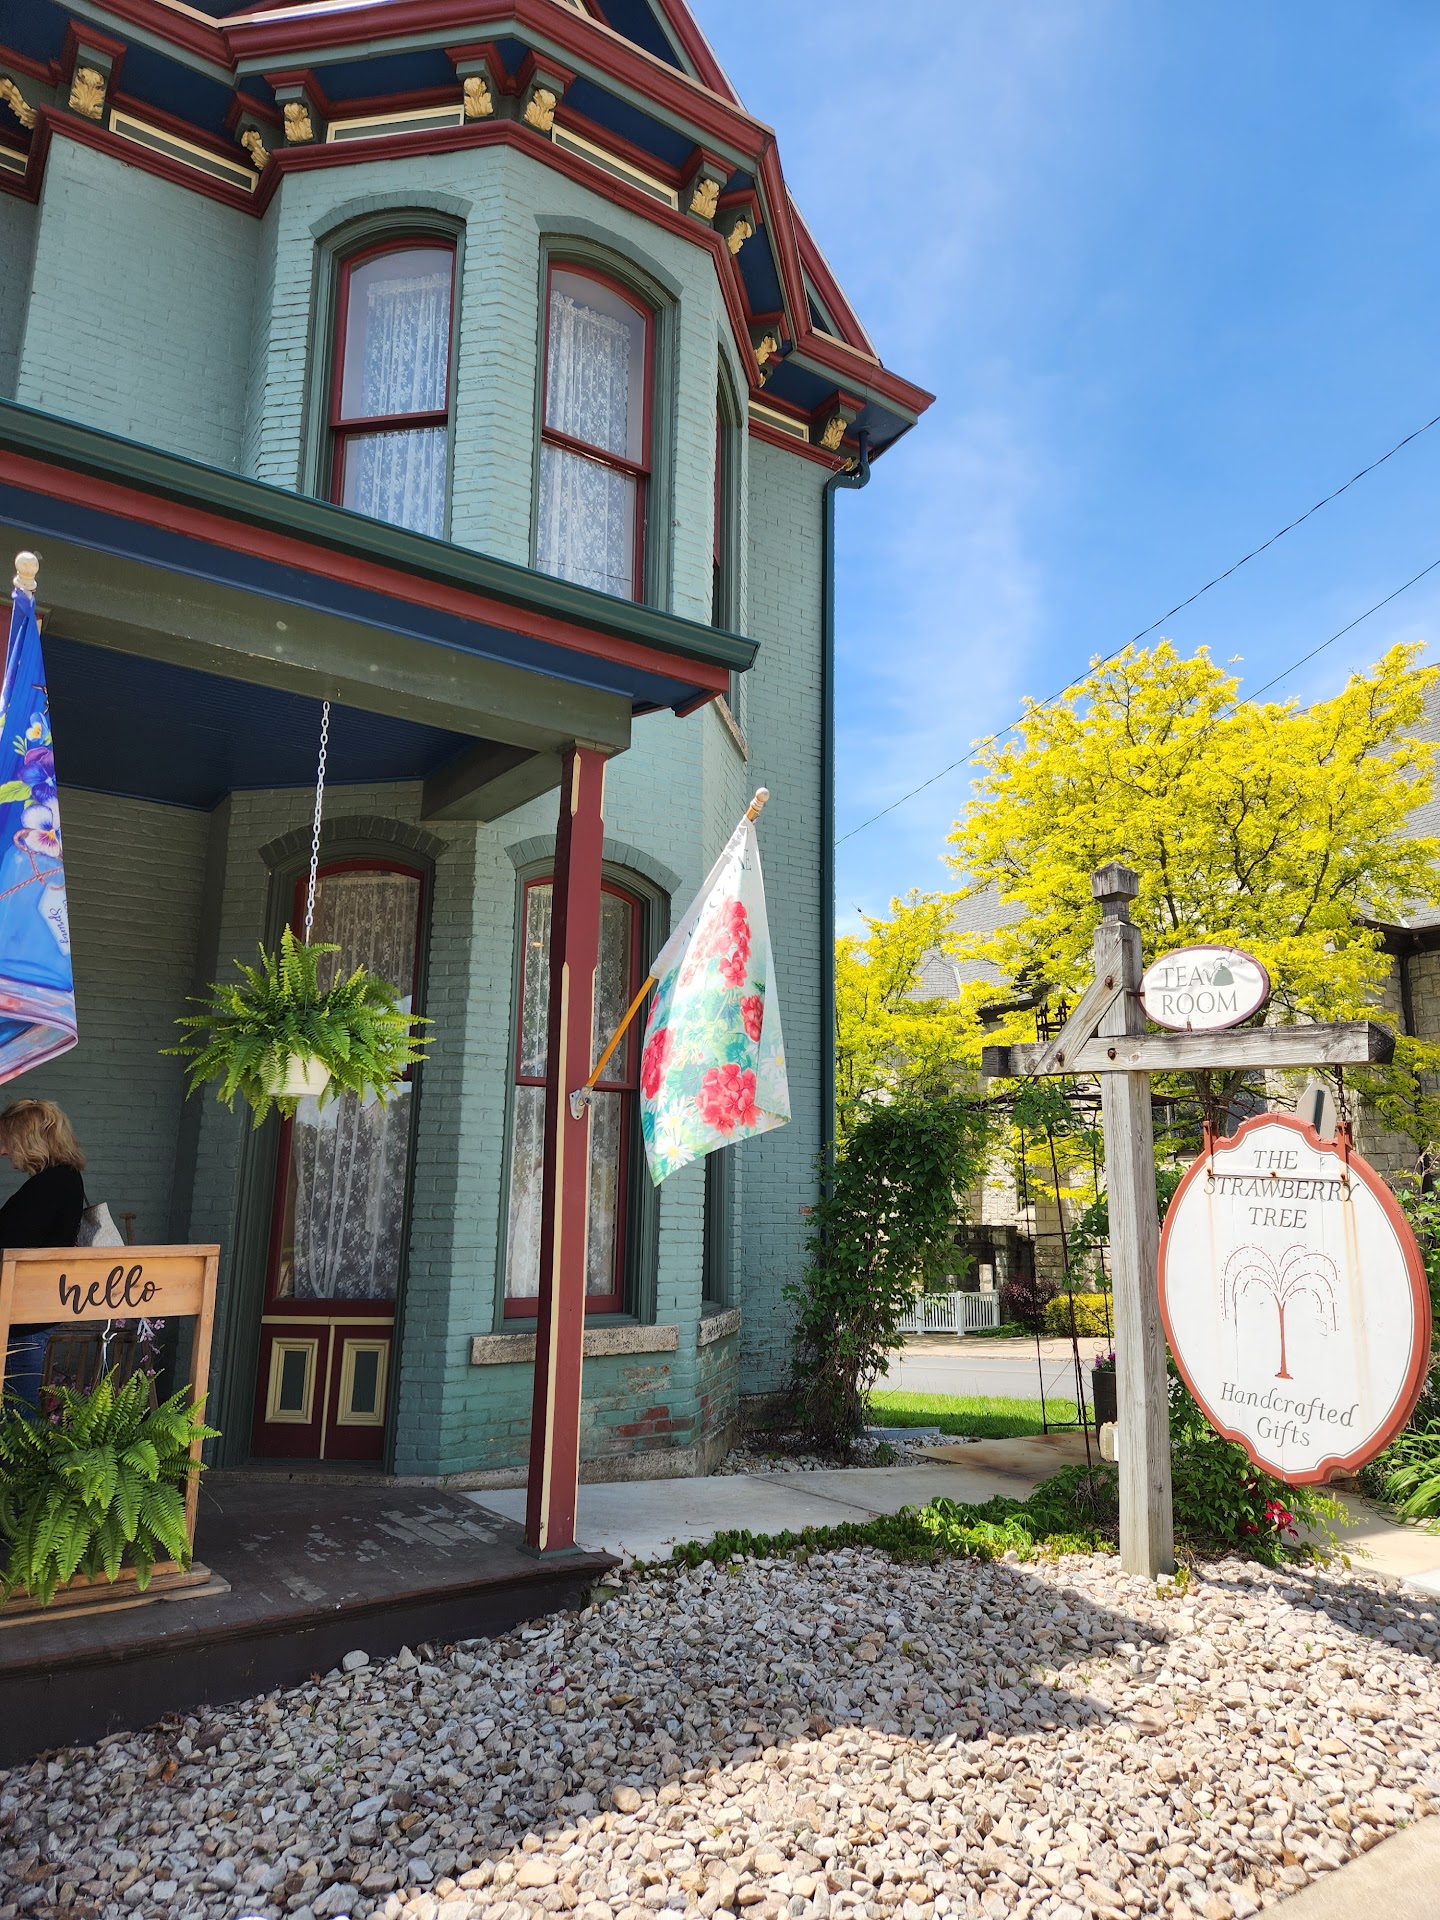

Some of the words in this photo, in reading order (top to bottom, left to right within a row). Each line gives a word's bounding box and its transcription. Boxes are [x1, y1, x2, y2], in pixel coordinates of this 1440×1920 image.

[1159, 965, 1206, 988] TEA
[1161, 990, 1238, 1015] ROOM
[1253, 1150, 1299, 1170] THE
[1203, 1176, 1361, 1202] STRAWBERRY
[1248, 1206, 1308, 1229] TREE
[59, 1264, 162, 1314] hello
[1220, 1381, 1360, 1428] Handcrafted
[1256, 1416, 1311, 1448] Gifts
